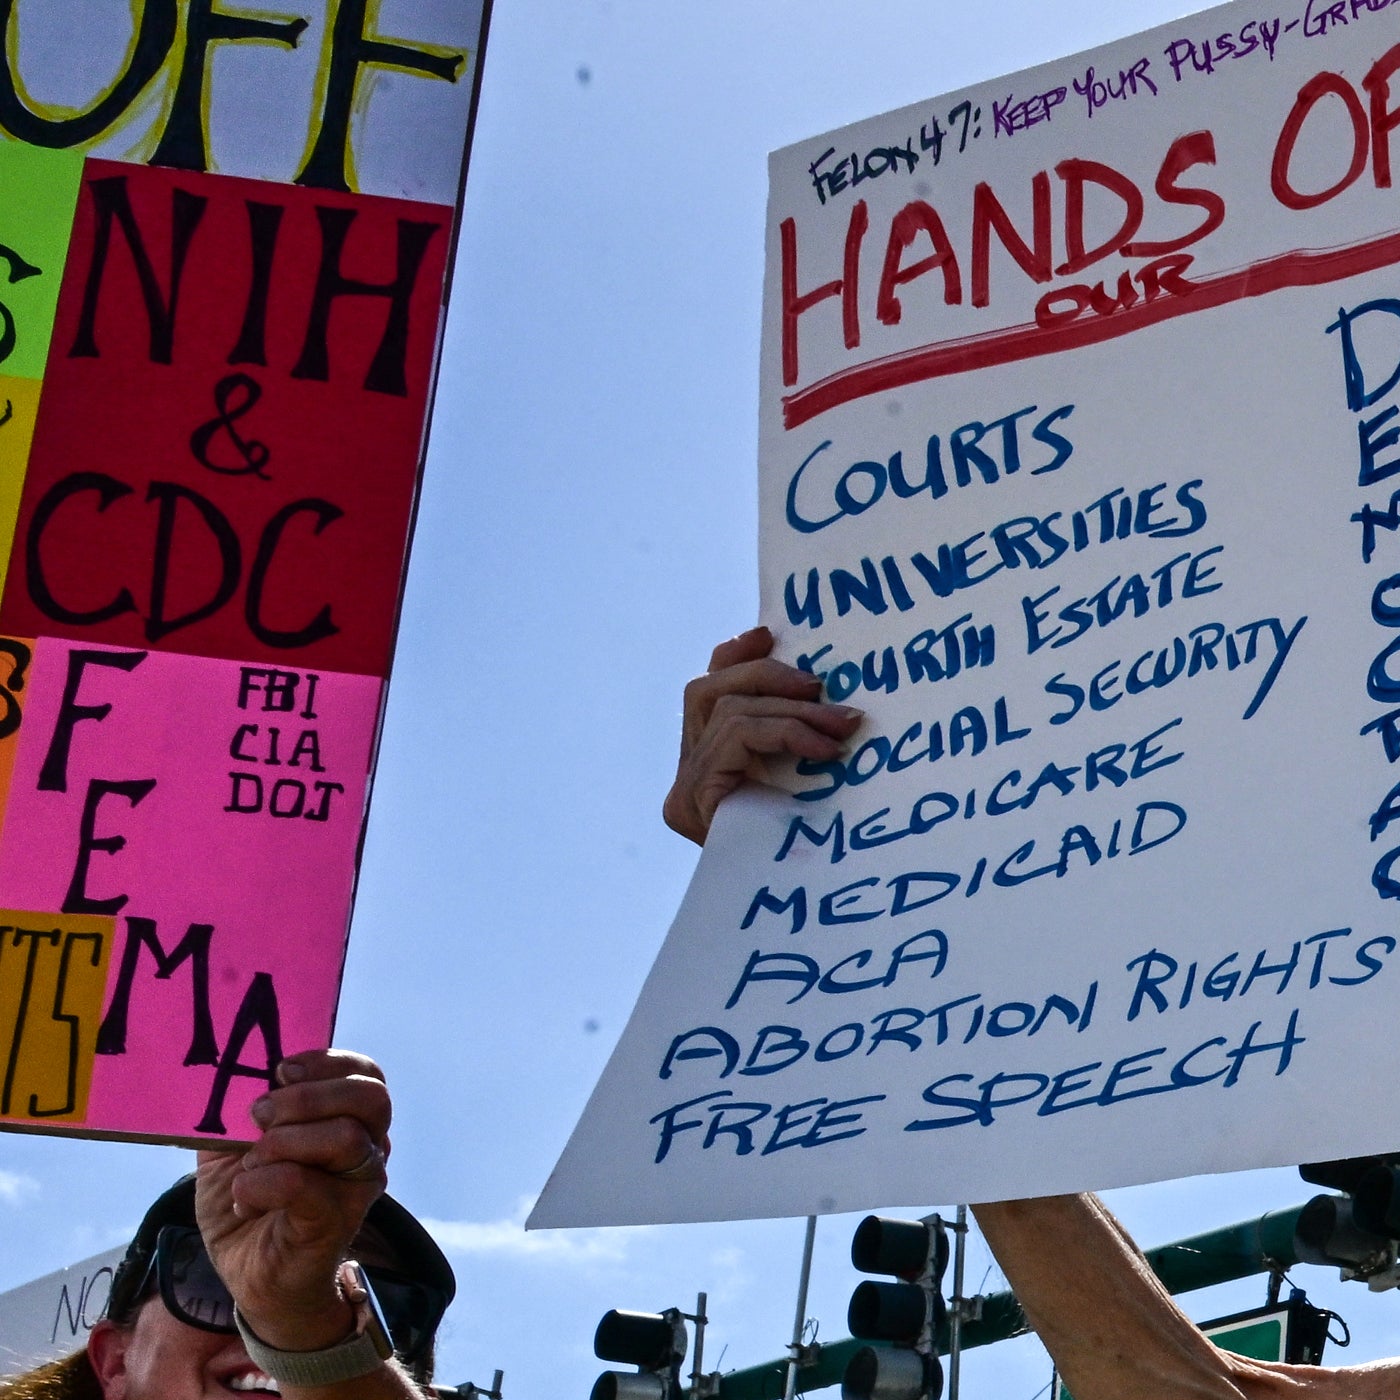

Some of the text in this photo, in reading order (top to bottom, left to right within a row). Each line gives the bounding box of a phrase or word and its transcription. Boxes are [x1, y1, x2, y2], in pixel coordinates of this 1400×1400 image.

[808, 138, 919, 205] FELON
[920, 100, 982, 166] 47:
[992, 87, 1067, 138] KEEP
[1073, 58, 1157, 118] YOUR
[68, 176, 442, 397] NIH
[782, 132, 1225, 385] HANDS
[1034, 253, 1199, 330] OUR
[190, 372, 272, 481] &
[788, 405, 1073, 534] COURTS
[26, 471, 346, 648] CDC
[784, 479, 1207, 629] UNIVERSITIES
[796, 545, 1223, 702] FOURTH ESTATE
[231, 725, 324, 771] CIA
[238, 666, 321, 719] FBI
[796, 616, 1308, 802] SOCIAL SECURITY
[225, 773, 344, 821] DOJ
[777, 717, 1184, 863] MEDICARE
[742, 801, 1187, 932] MEDICAID
[0, 926, 103, 1116] TS
[658, 927, 1396, 1080] ABORTION RIGHTS
[732, 929, 948, 1004] ACA
[649, 1008, 1306, 1164] FREE SPEECH
